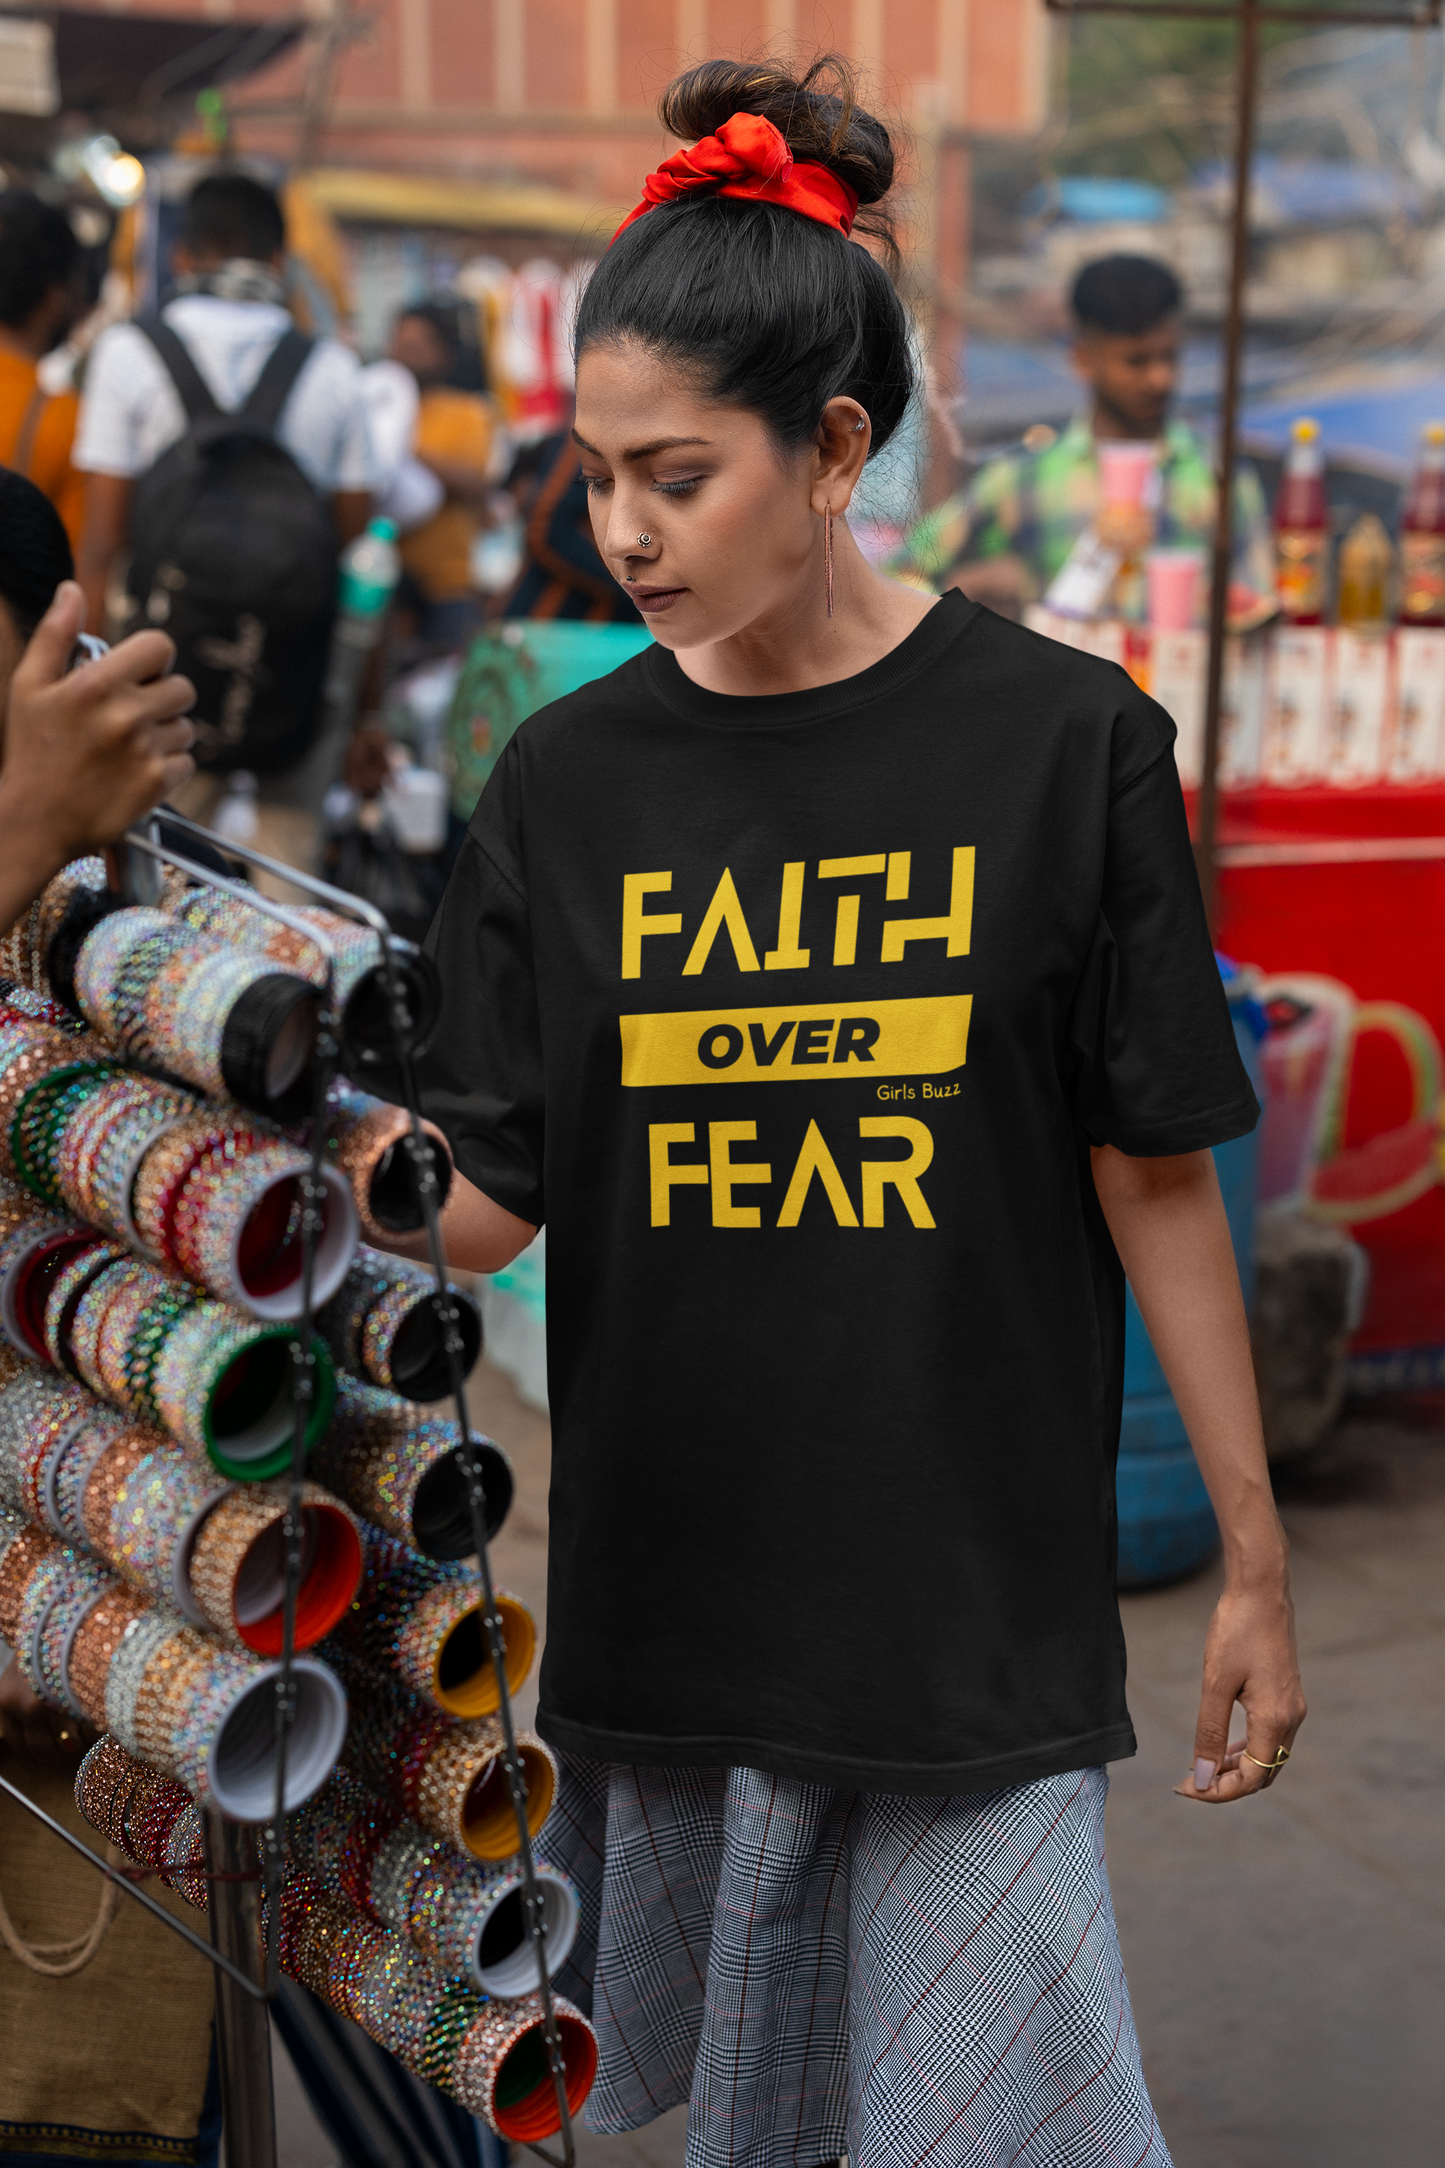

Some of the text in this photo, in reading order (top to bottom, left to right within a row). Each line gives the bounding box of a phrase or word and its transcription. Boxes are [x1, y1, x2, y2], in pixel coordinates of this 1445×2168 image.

[621, 845, 976, 980] FAITH
[697, 1016, 881, 1070] OVER
[876, 1082, 961, 1101] Girls Buzz
[648, 1115, 937, 1229] FEAR
